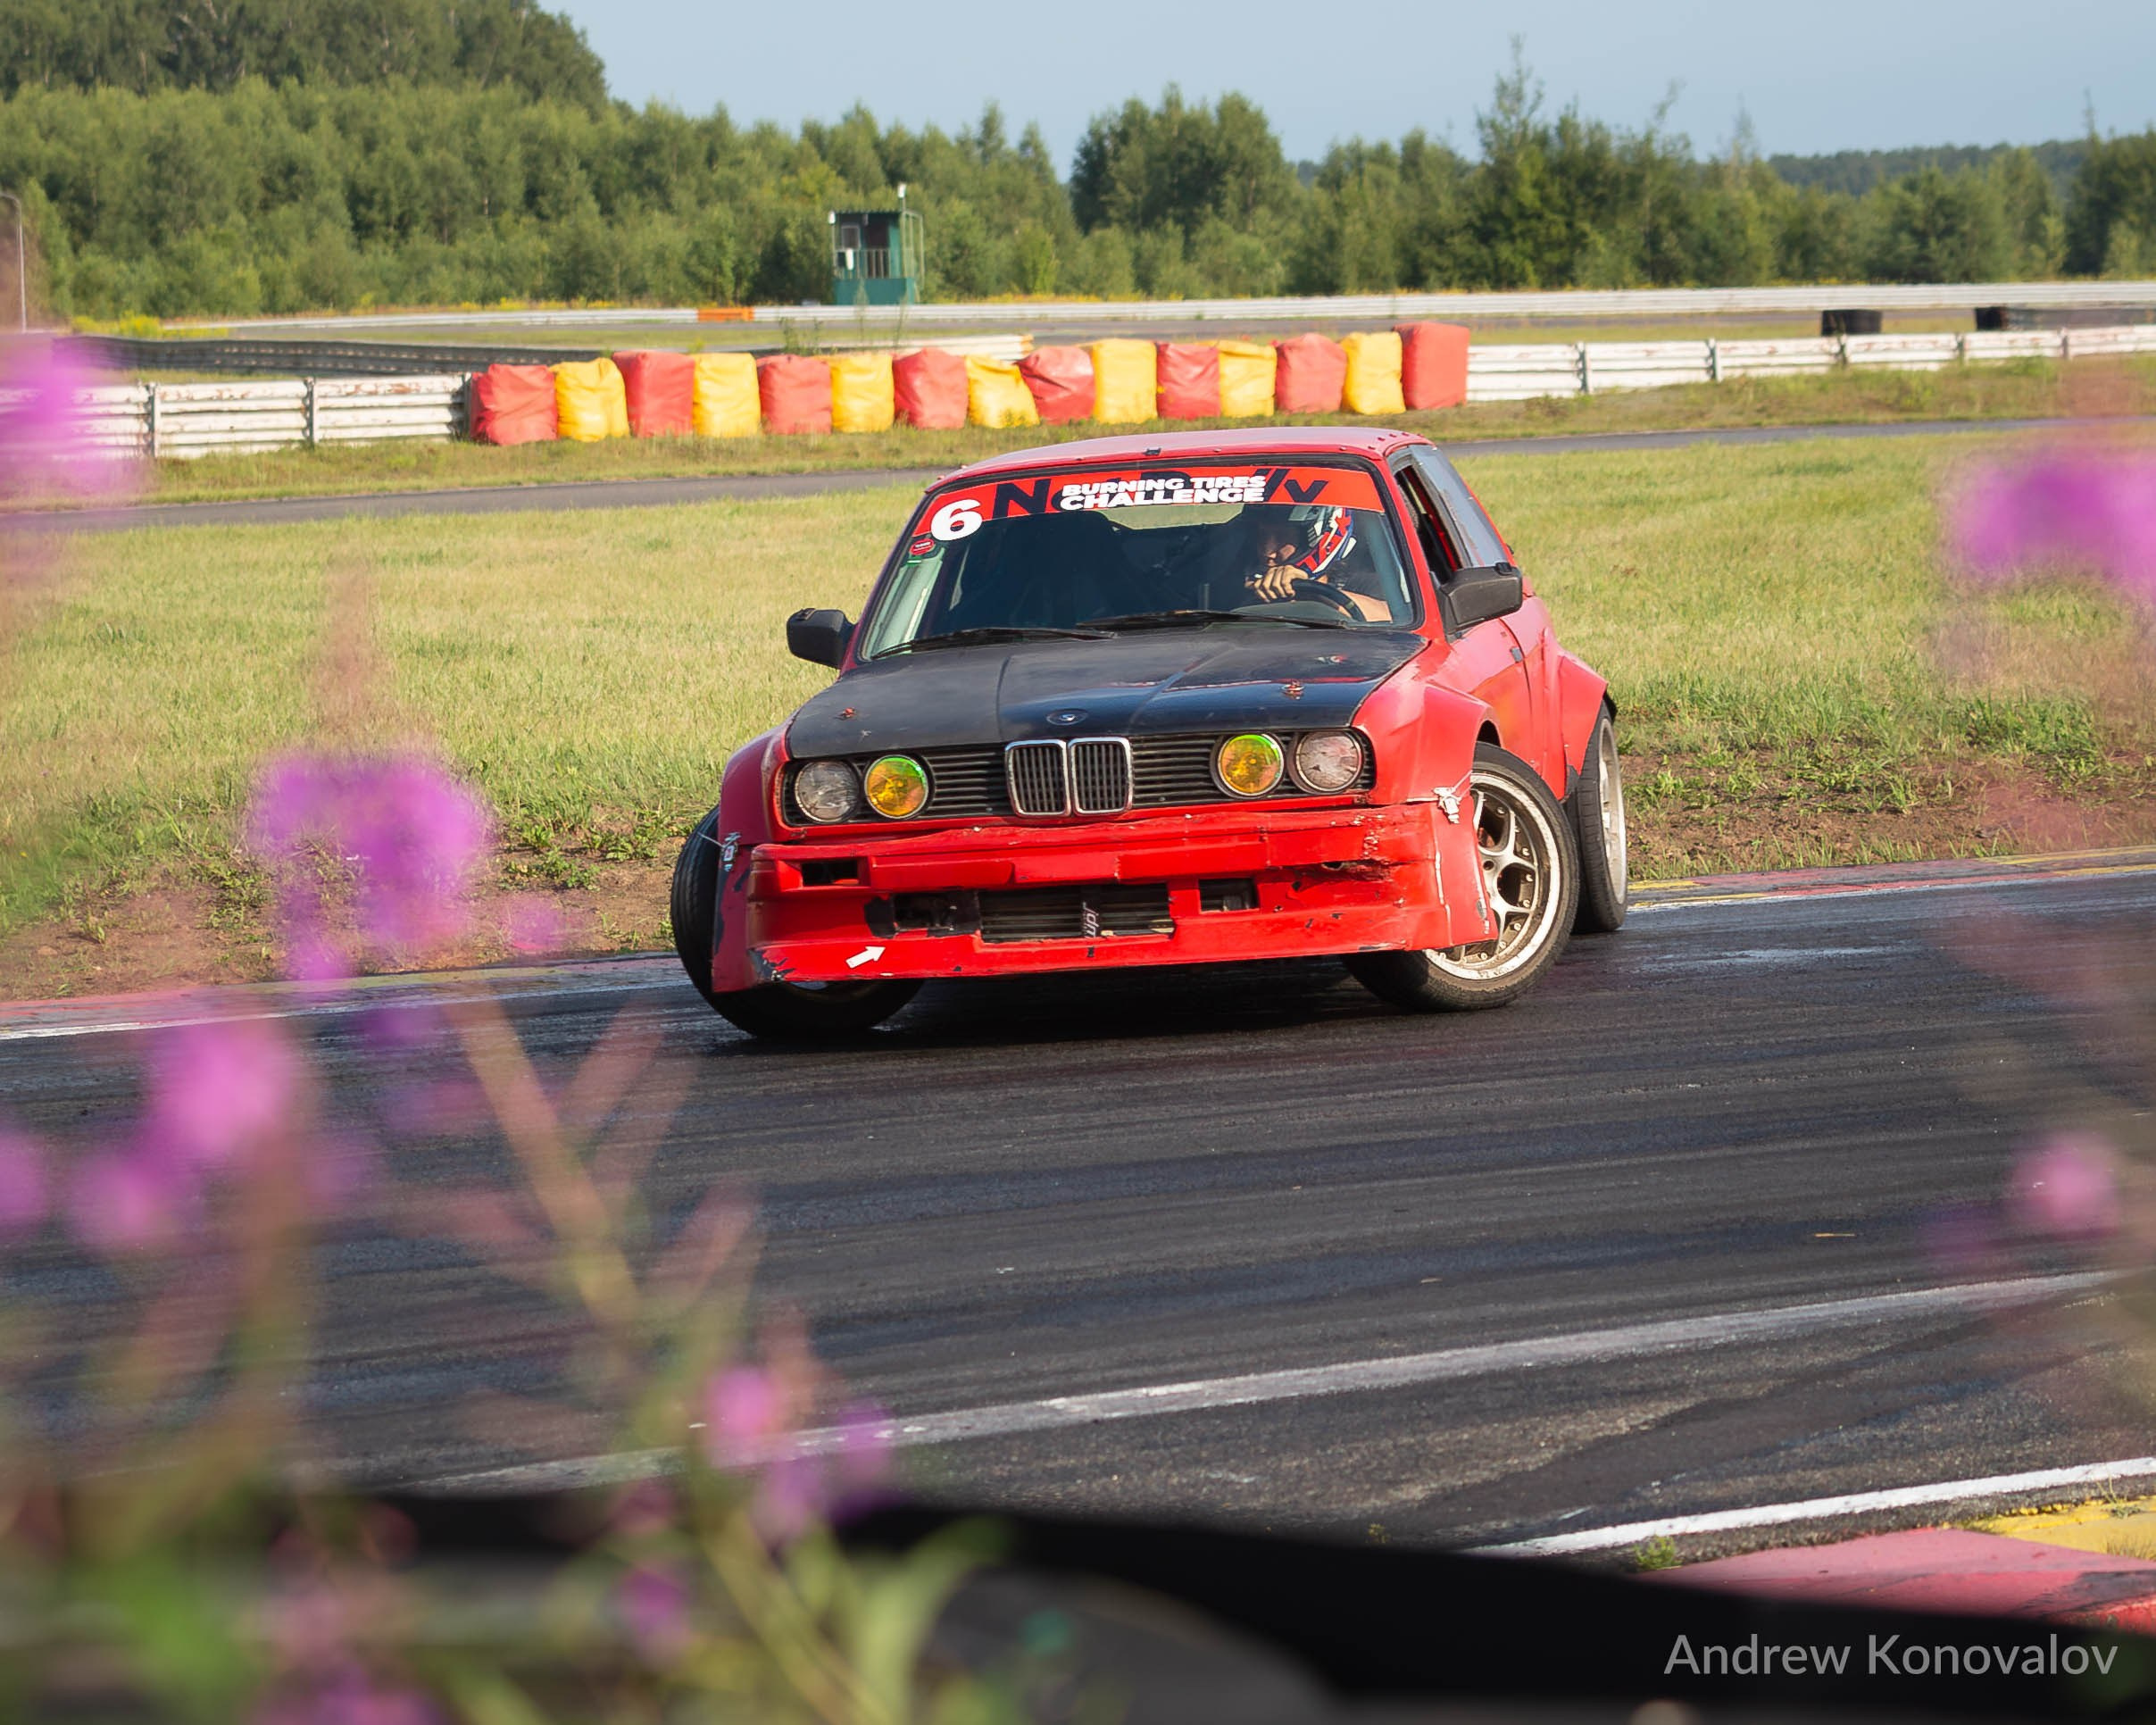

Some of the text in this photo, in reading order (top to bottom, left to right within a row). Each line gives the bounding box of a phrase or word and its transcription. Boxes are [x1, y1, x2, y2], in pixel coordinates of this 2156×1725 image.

[1061, 475, 1267, 497] BURNING TIRES
[1060, 487, 1266, 511] CHALLENGE
[930, 498, 983, 541] 6
